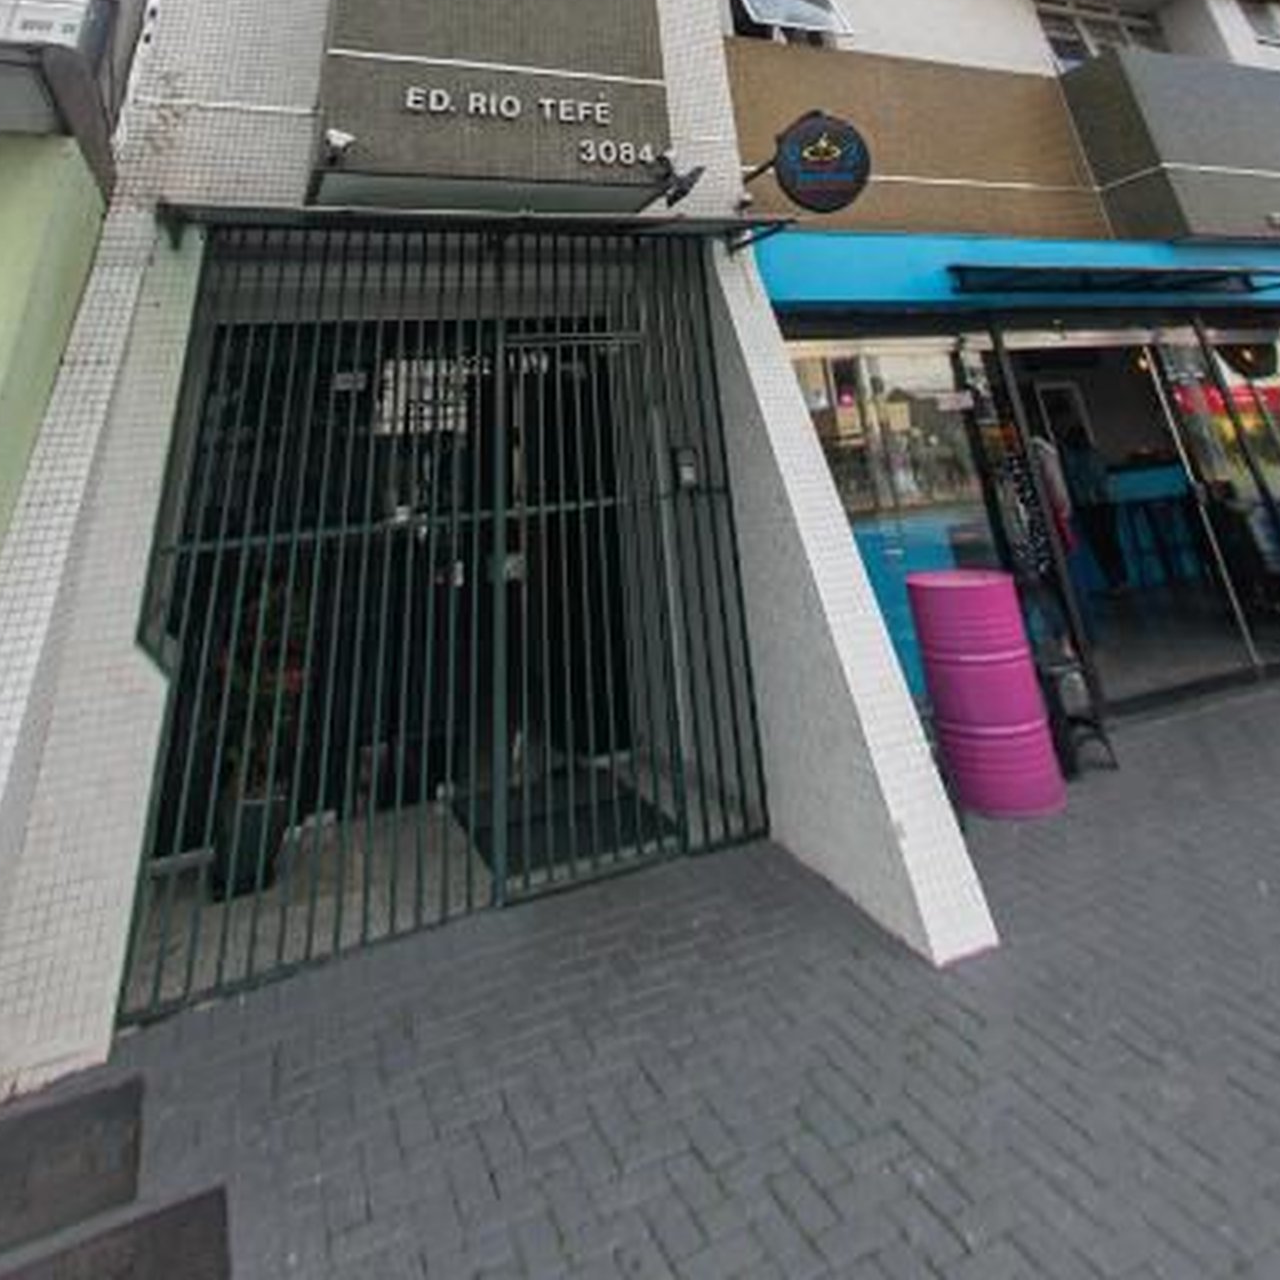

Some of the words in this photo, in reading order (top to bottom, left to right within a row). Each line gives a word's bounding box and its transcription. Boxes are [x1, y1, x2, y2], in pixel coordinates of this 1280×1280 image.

[406, 86, 456, 112] ED.
[469, 93, 521, 118] RIO
[580, 139, 656, 164] 3084
